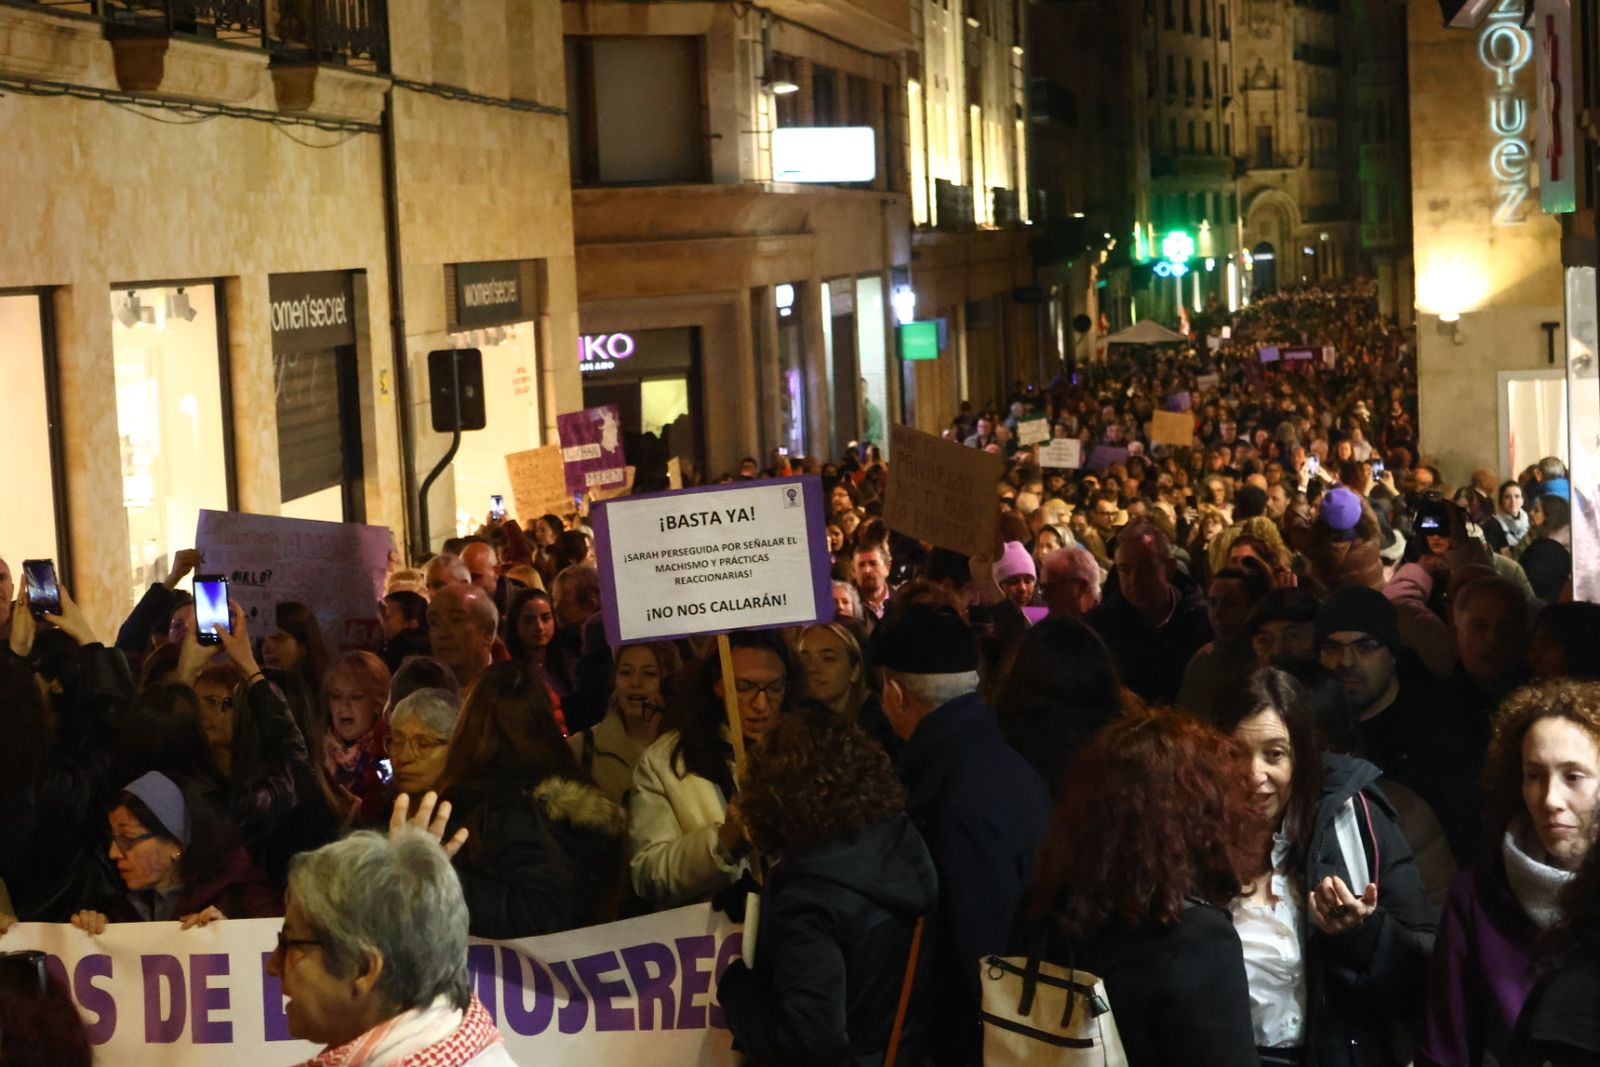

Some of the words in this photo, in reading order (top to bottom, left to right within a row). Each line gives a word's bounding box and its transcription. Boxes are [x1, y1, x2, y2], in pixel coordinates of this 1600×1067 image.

[270, 291, 347, 332] omen'secret
[660, 511, 722, 532] ¡BASTA
[726, 506, 755, 523] YA!
[624, 551, 659, 563] ¡SARAH
[661, 545, 719, 558] PERSEGUIDA
[722, 543, 741, 551] POR
[743, 537, 784, 550] SEÑALAR
[787, 537, 797, 545] EL
[655, 560, 709, 573] MACHISMO
[711, 559, 717, 567] Y
[720, 553, 769, 566] PRÁCTICAS
[674, 569, 753, 585] REACCIONARIAS!
[647, 606, 673, 621] ¡NO
[677, 603, 706, 616] NOS
[710, 593, 787, 613] CALLARÁN!
[140, 953, 234, 1044] DE
